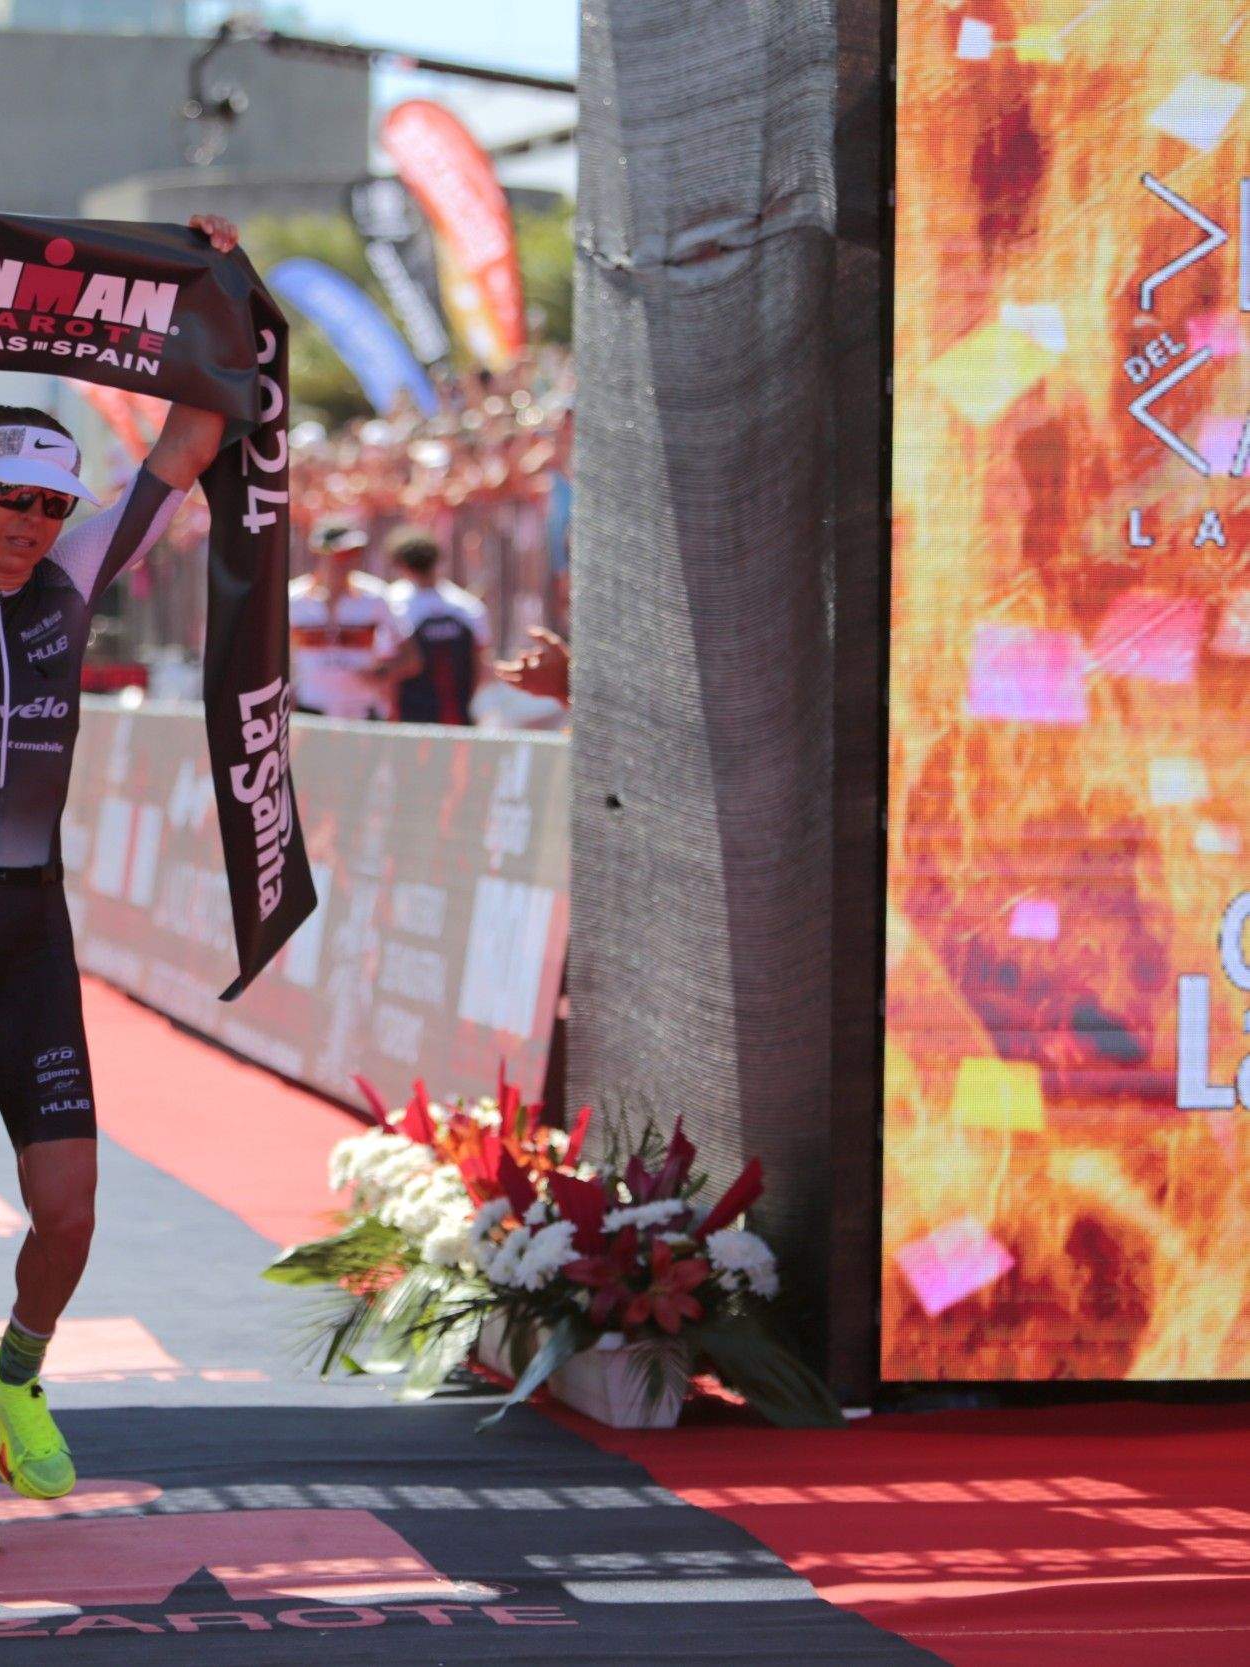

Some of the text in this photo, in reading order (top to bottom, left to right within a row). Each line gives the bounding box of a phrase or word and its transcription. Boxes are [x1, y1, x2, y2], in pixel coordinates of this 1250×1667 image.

[50, 340, 160, 376] SPAIN
[1123, 332, 1186, 385] DEL
[27, 635, 68, 662] HUUB
[40, 1099, 90, 1115] HUUB
